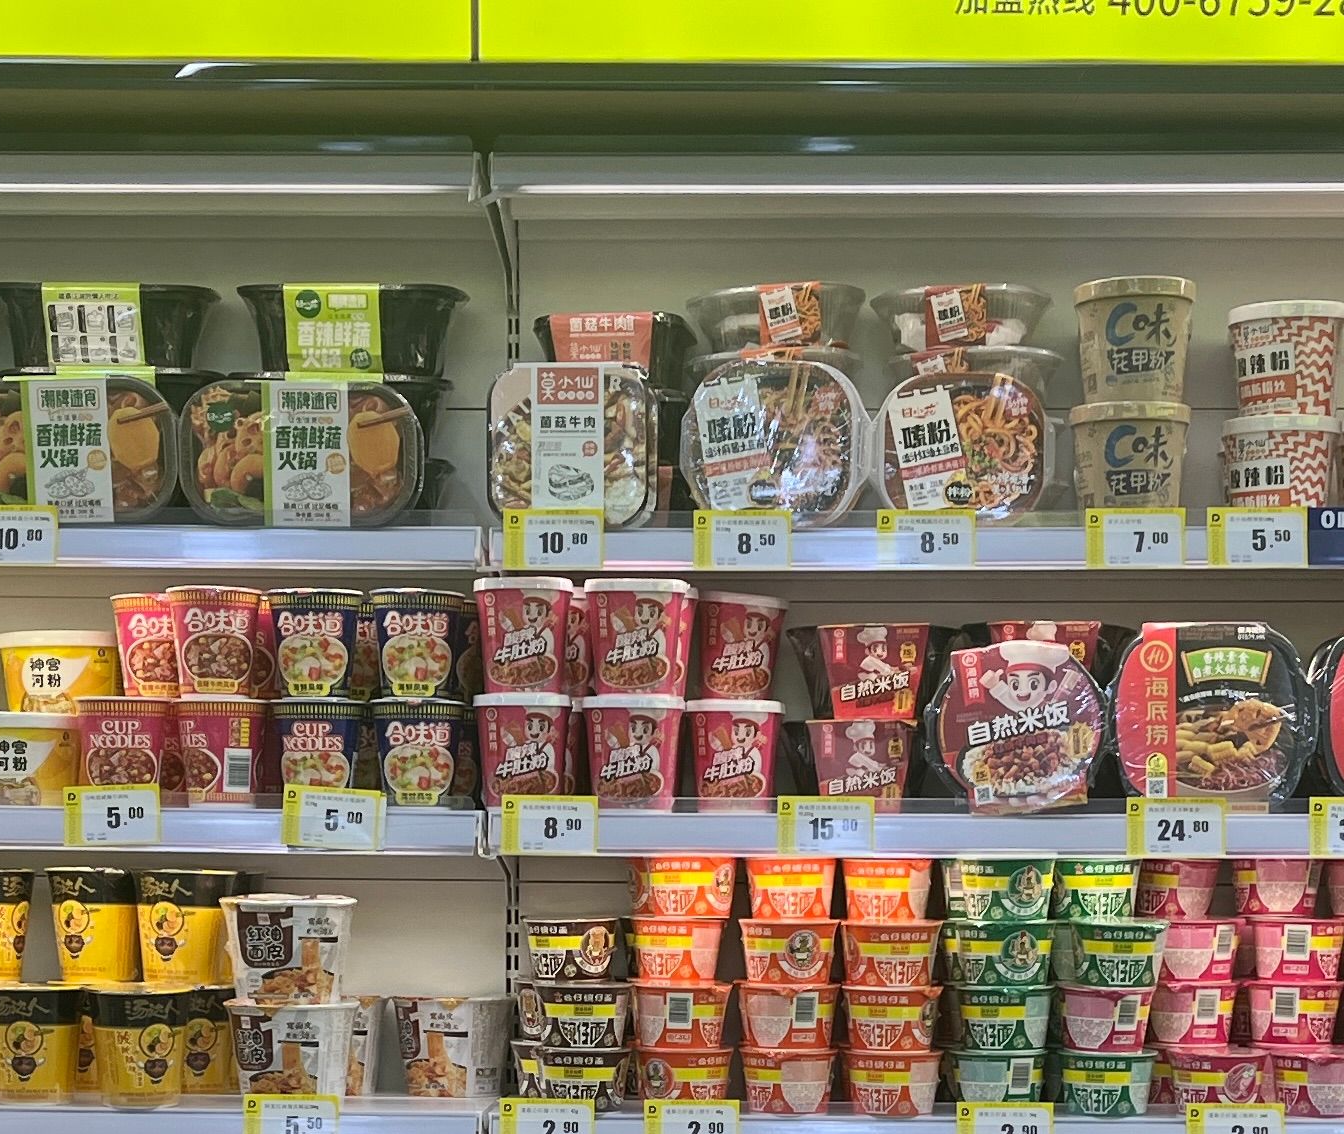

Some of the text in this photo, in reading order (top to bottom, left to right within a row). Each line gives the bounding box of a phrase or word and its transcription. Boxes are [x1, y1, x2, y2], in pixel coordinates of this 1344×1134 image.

[1111, 350, 1166, 372] 花甲粉
[540, 415, 596, 430] 菌菇牛肉
[37, 425, 102, 448] 香辣鲜蔬
[275, 426, 341, 450] 香辣鲜蔬
[1109, 470, 1164, 493] 花甲粉
[539, 532, 588, 554] 10.80
[738, 533, 776, 554] 8.50
[921, 532, 959, 553] 8.50
[1133, 530, 1168, 553] 7.00
[1252, 528, 1291, 551] 5.50
[184, 608, 250, 634] 合味道
[278, 611, 343, 637] 合味道
[381, 610, 447, 637] 合味道
[606, 638, 658, 664] 牛肚粉
[712, 650, 763, 672] 牛肚粉
[840, 670, 910, 702] 自热米饭
[1144, 676, 1169, 745] 海底捞
[101, 720, 140, 735] CUP
[292, 722, 332, 738] CUP
[966, 700, 1071, 746] 自热米饭
[89, 734, 152, 749] NOODLES
[828, 766, 897, 796] 自热米饭
[107, 806, 144, 829] 5.00
[325, 809, 363, 831] 5.00
[544, 817, 582, 839] 8.90
[1157, 818, 1209, 843] 24.80
